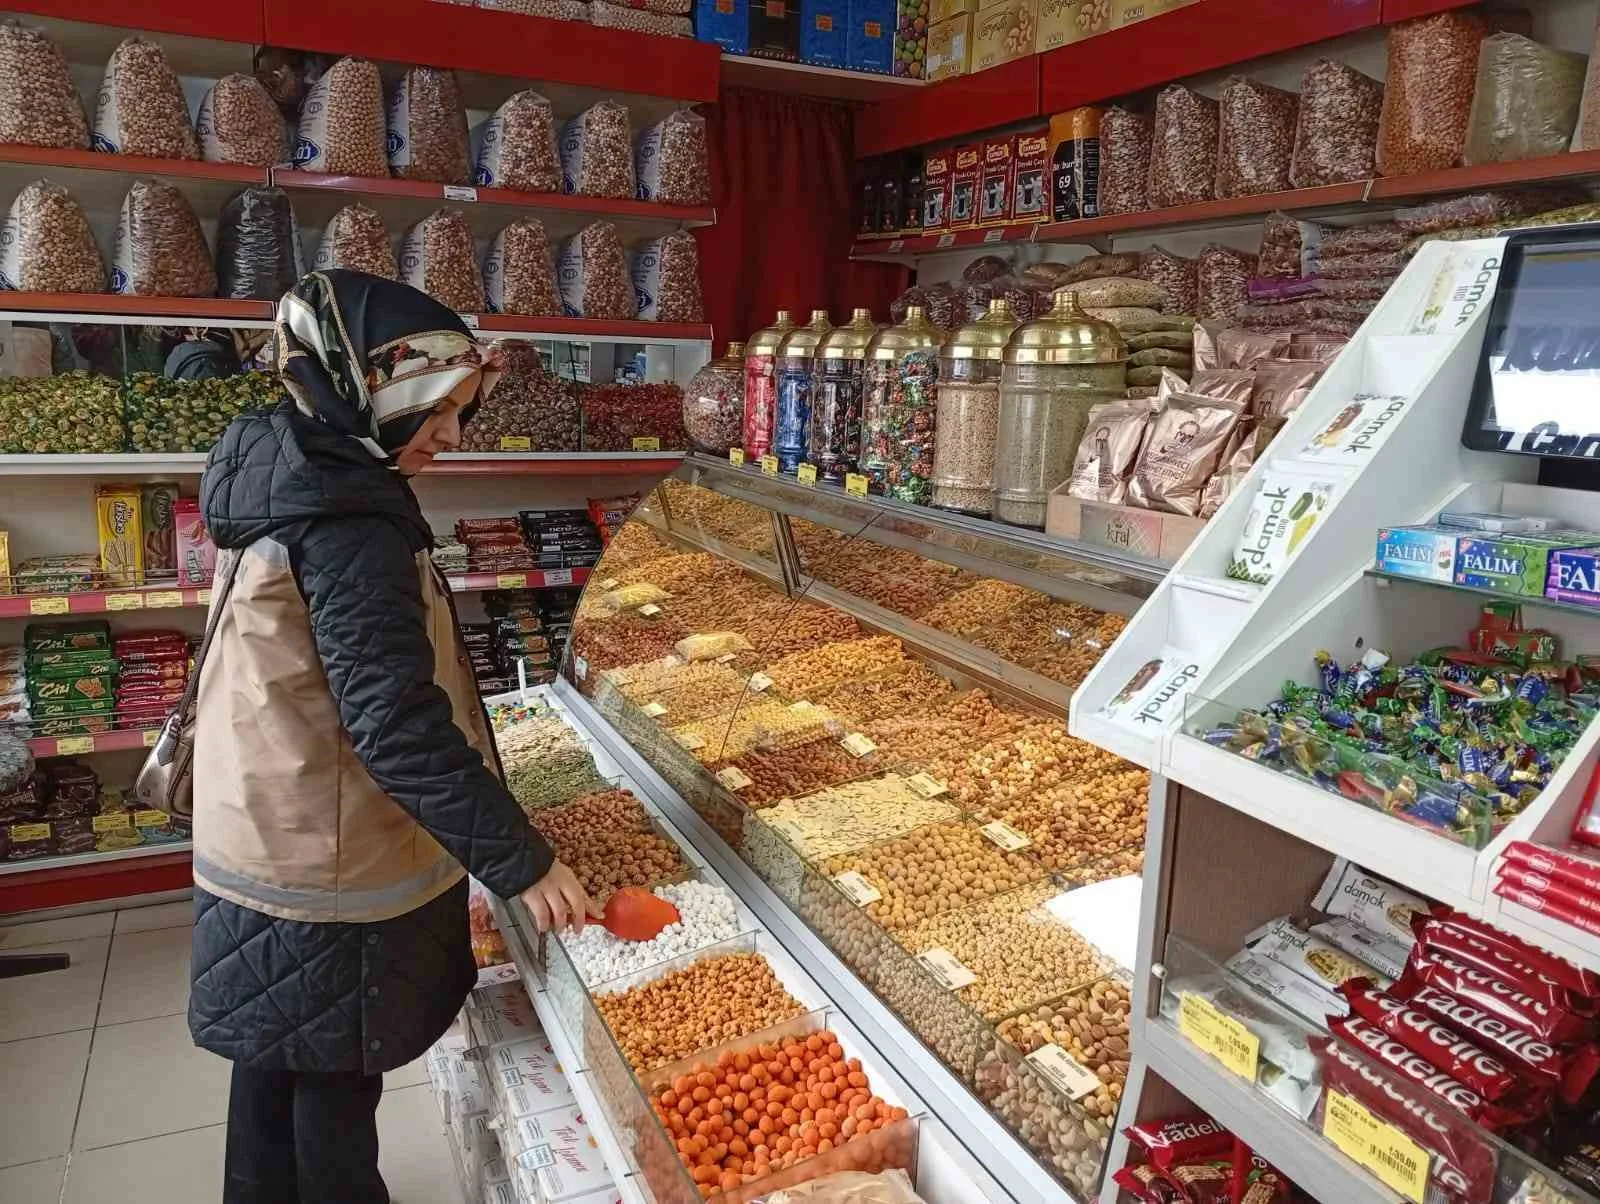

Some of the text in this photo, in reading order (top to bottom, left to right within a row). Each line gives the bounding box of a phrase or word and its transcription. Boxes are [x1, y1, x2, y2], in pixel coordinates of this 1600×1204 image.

[1058, 175, 1071, 189] 69
[1242, 486, 1290, 565] damak
[1384, 543, 1434, 563] FALIM
[1464, 554, 1519, 575] FALIM
[1134, 664, 1200, 725] damak
[1344, 879, 1386, 910] damak
[1271, 919, 1311, 952] damak
